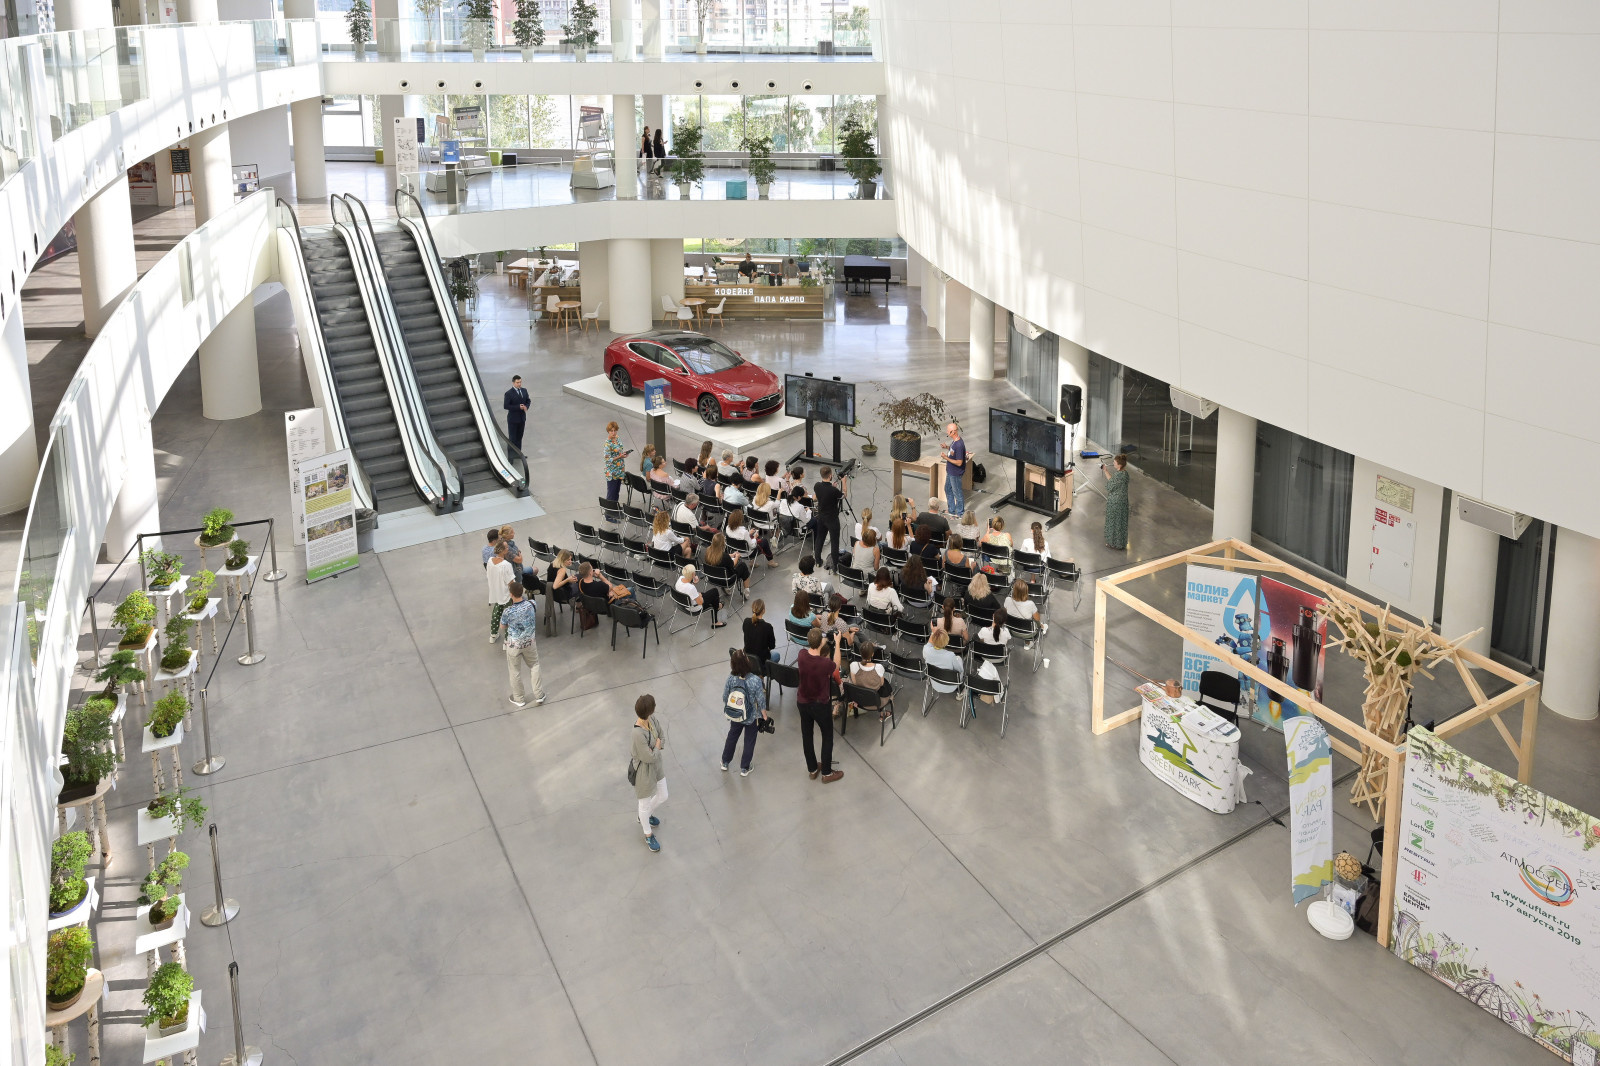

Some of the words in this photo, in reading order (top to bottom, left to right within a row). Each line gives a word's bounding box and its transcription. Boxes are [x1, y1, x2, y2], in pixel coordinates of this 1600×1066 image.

[714, 288, 754, 296] КОФЕЙНЯ
[754, 295, 777, 303] ПАПА
[780, 295, 805, 303] КАРЛО
[1148, 750, 1175, 775] GREEN
[1178, 771, 1201, 791] PARK
[1410, 820, 1435, 839] Lorberg
[1490, 891, 1515, 908] 14-17
[1516, 907, 1556, 932] августа
[1557, 928, 1582, 947] 2019
